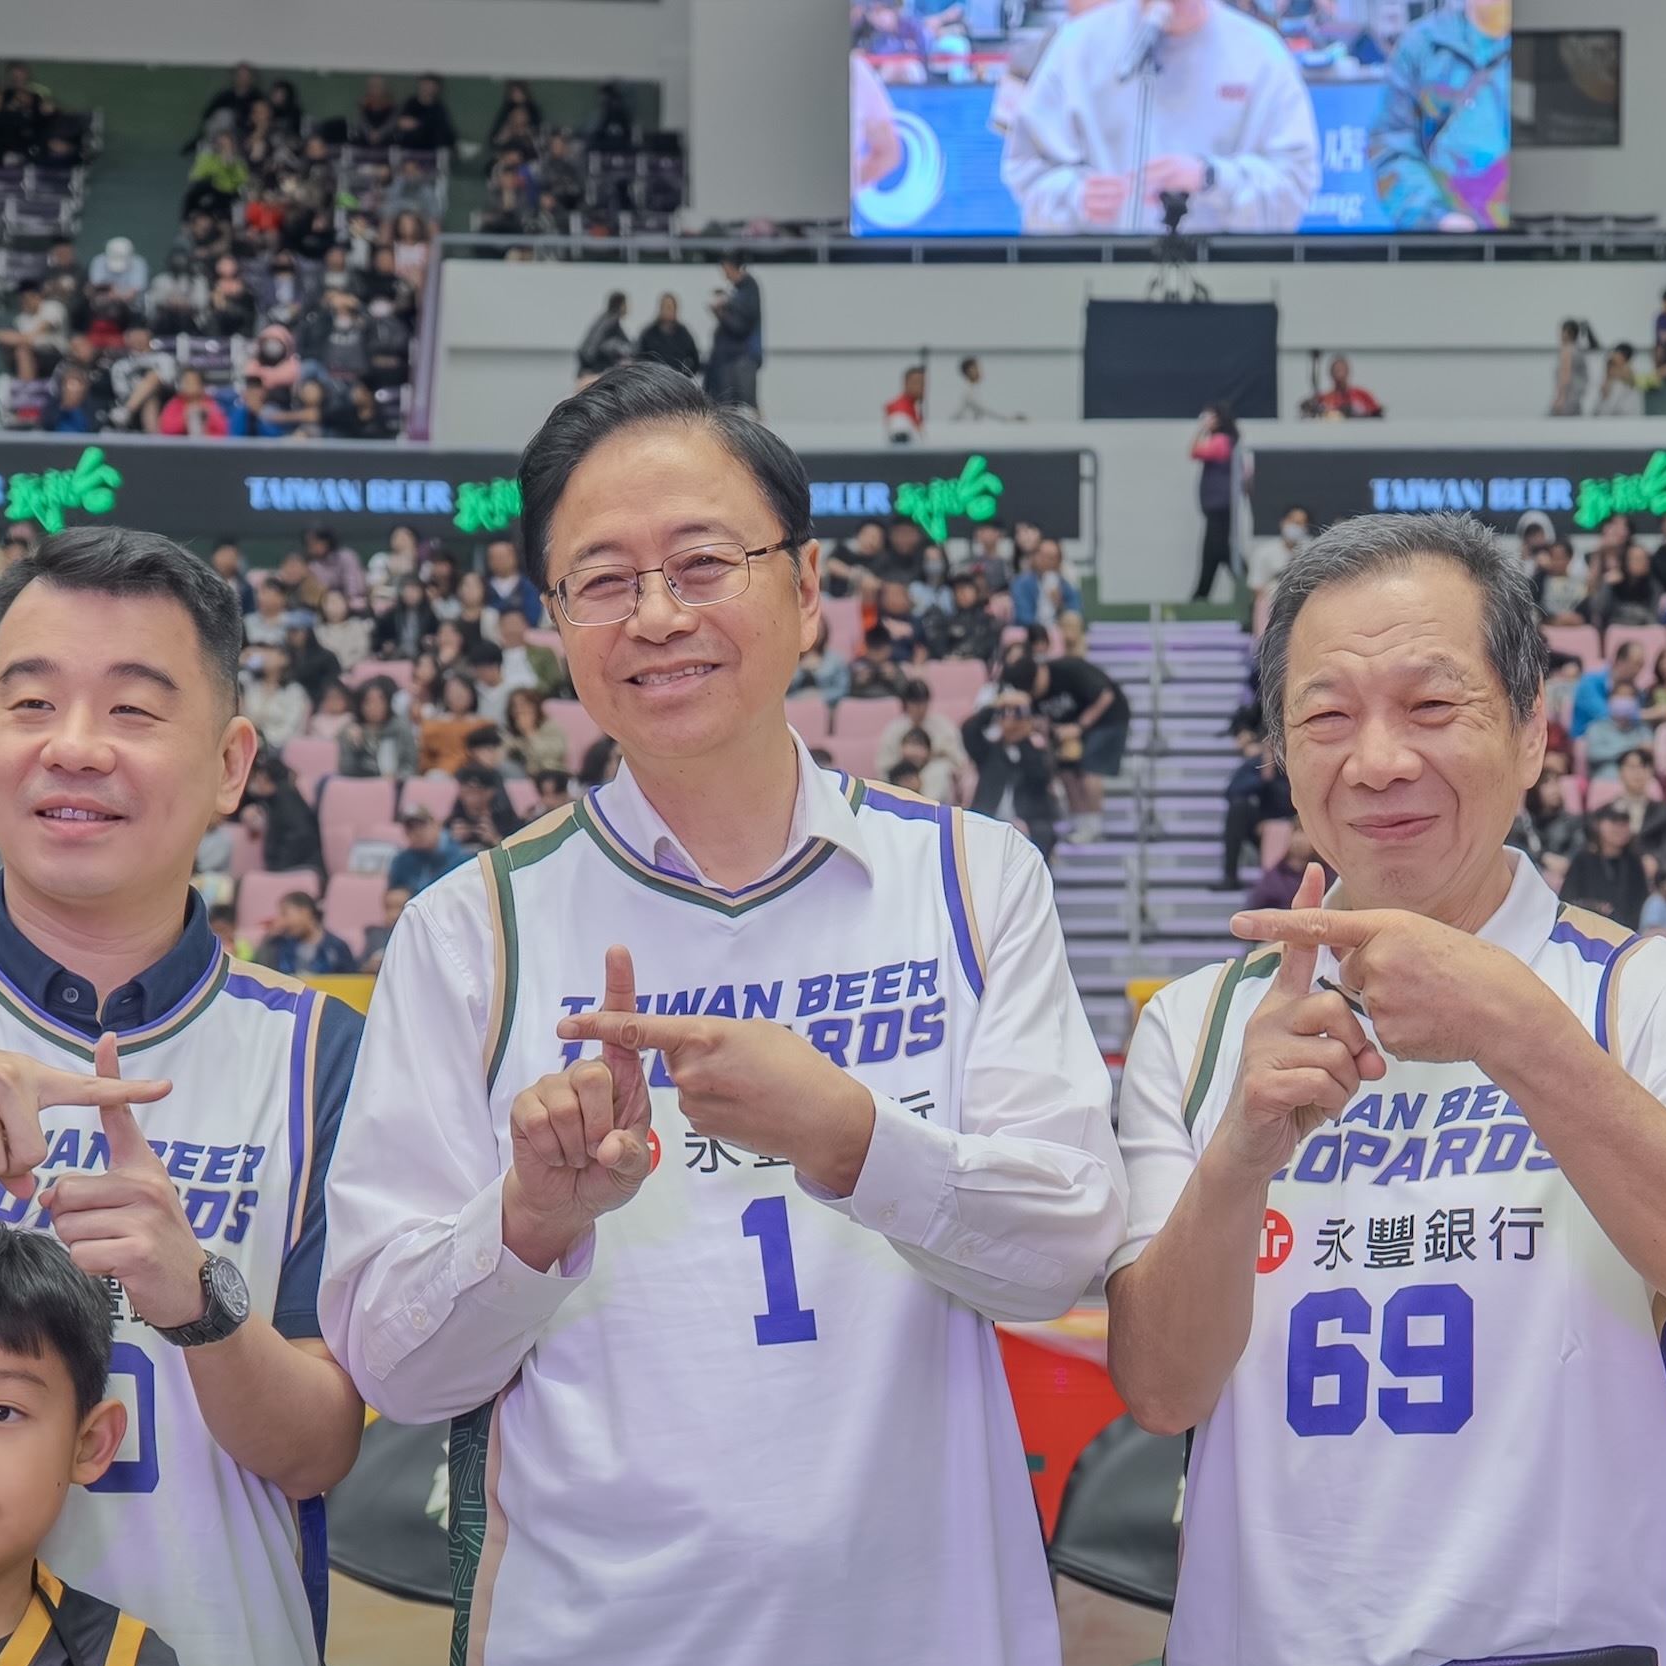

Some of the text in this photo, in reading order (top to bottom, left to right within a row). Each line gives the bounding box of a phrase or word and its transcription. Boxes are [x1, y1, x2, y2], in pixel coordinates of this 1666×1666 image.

[245, 477, 454, 513] TAIWAN BEER
[1370, 477, 1573, 511] TAIWAN BEER
[561, 957, 939, 1020] TIWAN BEER
[1433, 1084, 1525, 1130] BE
[1272, 1123, 1559, 1186] OPARD
[1313, 1206, 1544, 1270] 永豐銀行
[741, 1196, 818, 1346] 1
[1286, 1283, 1474, 1437] 69
